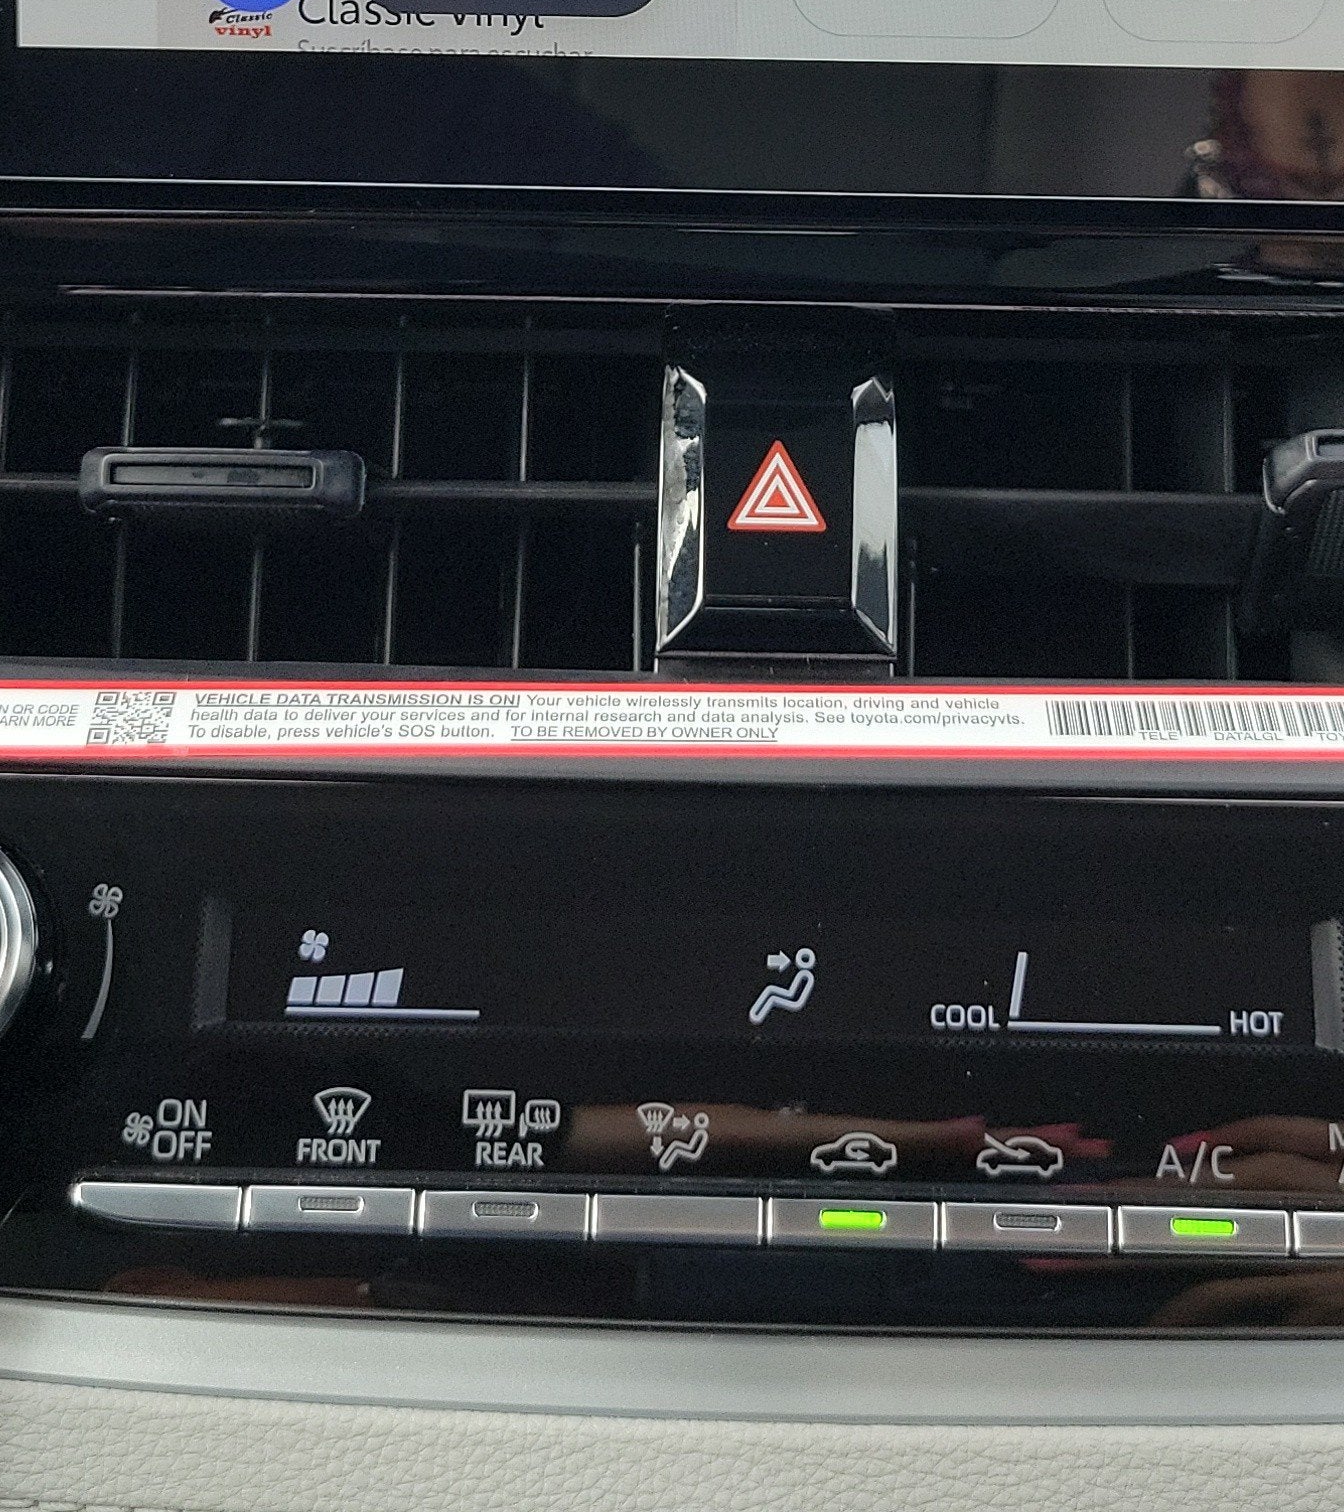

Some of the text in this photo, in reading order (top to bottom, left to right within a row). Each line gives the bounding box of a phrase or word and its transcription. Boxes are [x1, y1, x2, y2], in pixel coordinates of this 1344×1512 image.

[215, 24, 273, 40] vinyl
[12, 704, 33, 715] QR
[37, 704, 80, 715] CODE
[195, 692, 272, 706] VEHICLE
[276, 693, 322, 706] DATA
[326, 693, 463, 706] TRANSMISSION
[467, 694, 485, 706] IS
[526, 694, 561, 707] Your
[566, 694, 621, 708] vehicle
[626, 695, 702, 710] wirelessly
[706, 696, 778, 709] transmits
[783, 696, 848, 711] location,
[853, 696, 904, 711] driving
[910, 697, 940, 710] and
[945, 697, 1000, 710] vehicle
[33, 715, 78, 727] MORE
[190, 708, 238, 721] health
[243, 708, 278, 721] data
[284, 709, 299, 721] to
[305, 708, 357, 721] deliver
[360, 710, 396, 725] your
[400, 708, 465, 722] services
[471, 709, 500, 722] and
[505, 709, 526, 722] for
[531, 710, 589, 723] internal
[593, 710, 662, 723] research
[666, 711, 696, 723] and
[701, 711, 735, 723] data
[740, 712, 809, 726] analysis.
[814, 712, 846, 724] See
[188, 724, 779, 741] To disable, press vehicle's SOS button. TO BE REMOVED BY OWNER ONLY
[1138, 731, 1179, 741] TELE
[930, 1003, 1001, 1030] COOL
[1229, 1010, 1284, 1037] HOT
[157, 1098, 207, 1127] ON
[152, 1130, 213, 1161] OFF
[297, 1138, 381, 1164] FRONT
[475, 1140, 544, 1167] REAR
[1156, 1143, 1235, 1184] A/C
